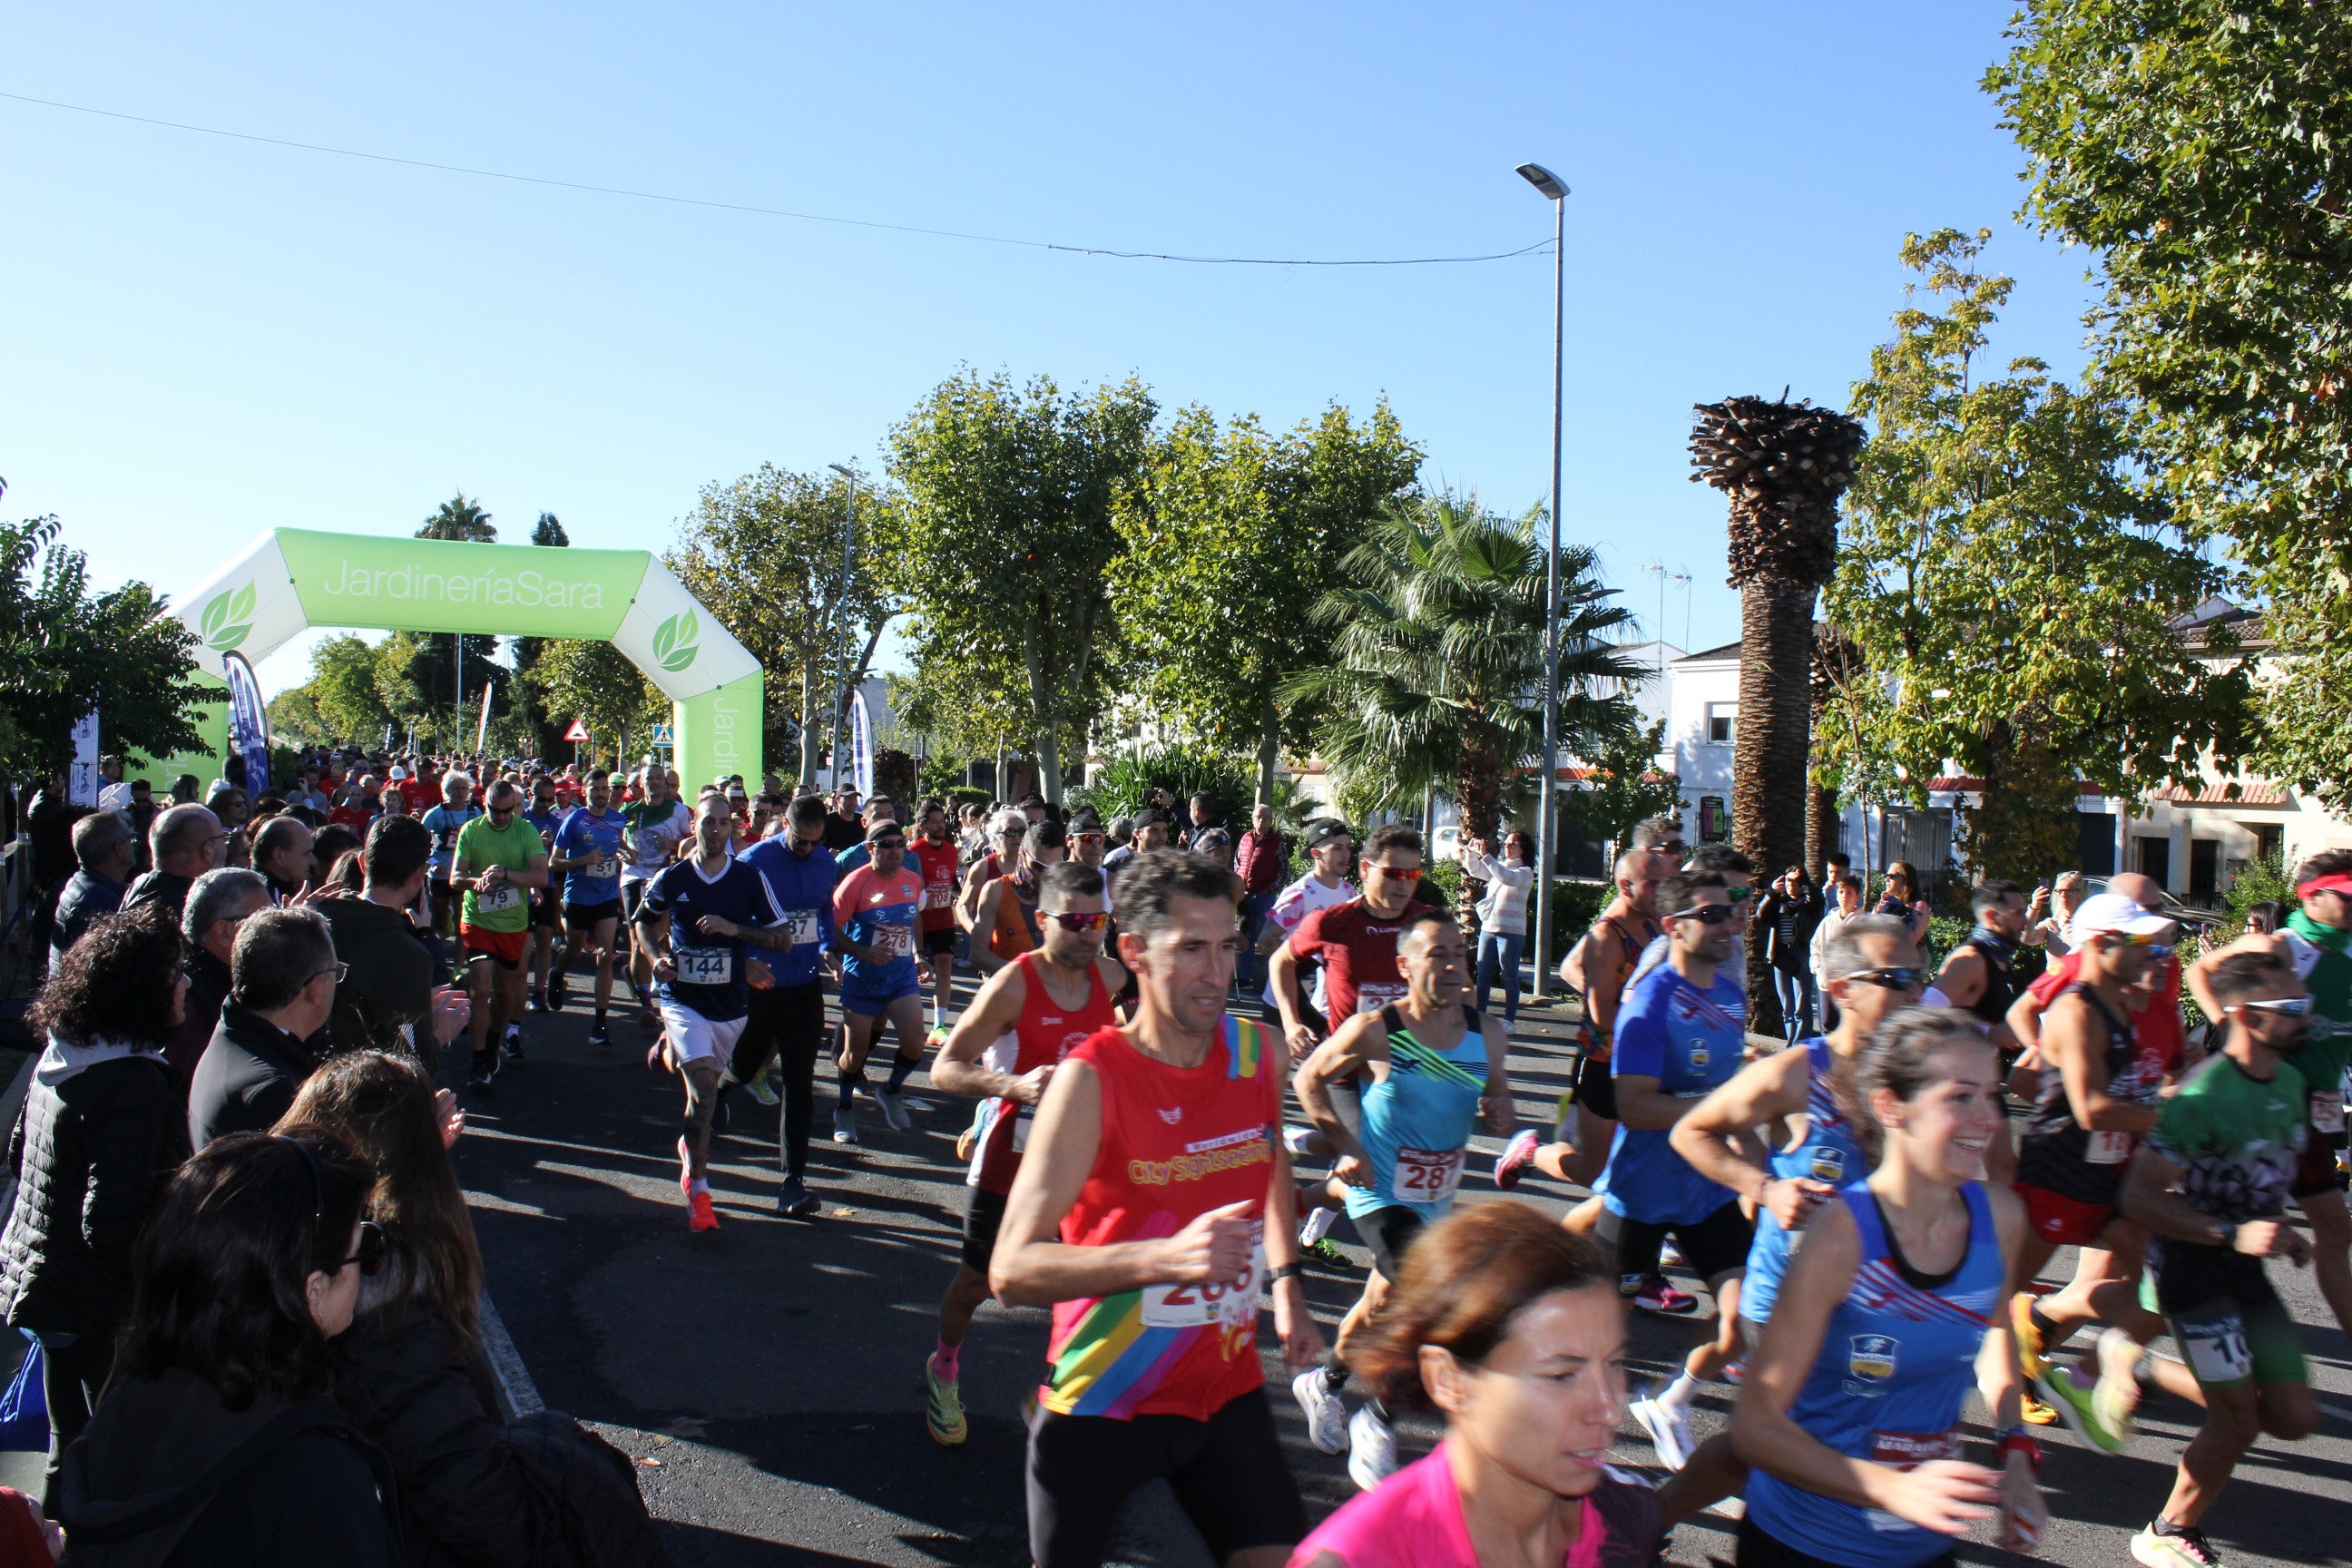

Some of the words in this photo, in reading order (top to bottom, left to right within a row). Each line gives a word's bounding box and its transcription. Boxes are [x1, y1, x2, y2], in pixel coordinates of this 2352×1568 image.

[324, 559, 603, 609] JardineríaSara
[596, 861, 612, 872] 51
[487, 891, 507, 905] 79
[878, 932, 907, 948] 278
[684, 956, 725, 975] 144
[1128, 1159, 1171, 1186] City
